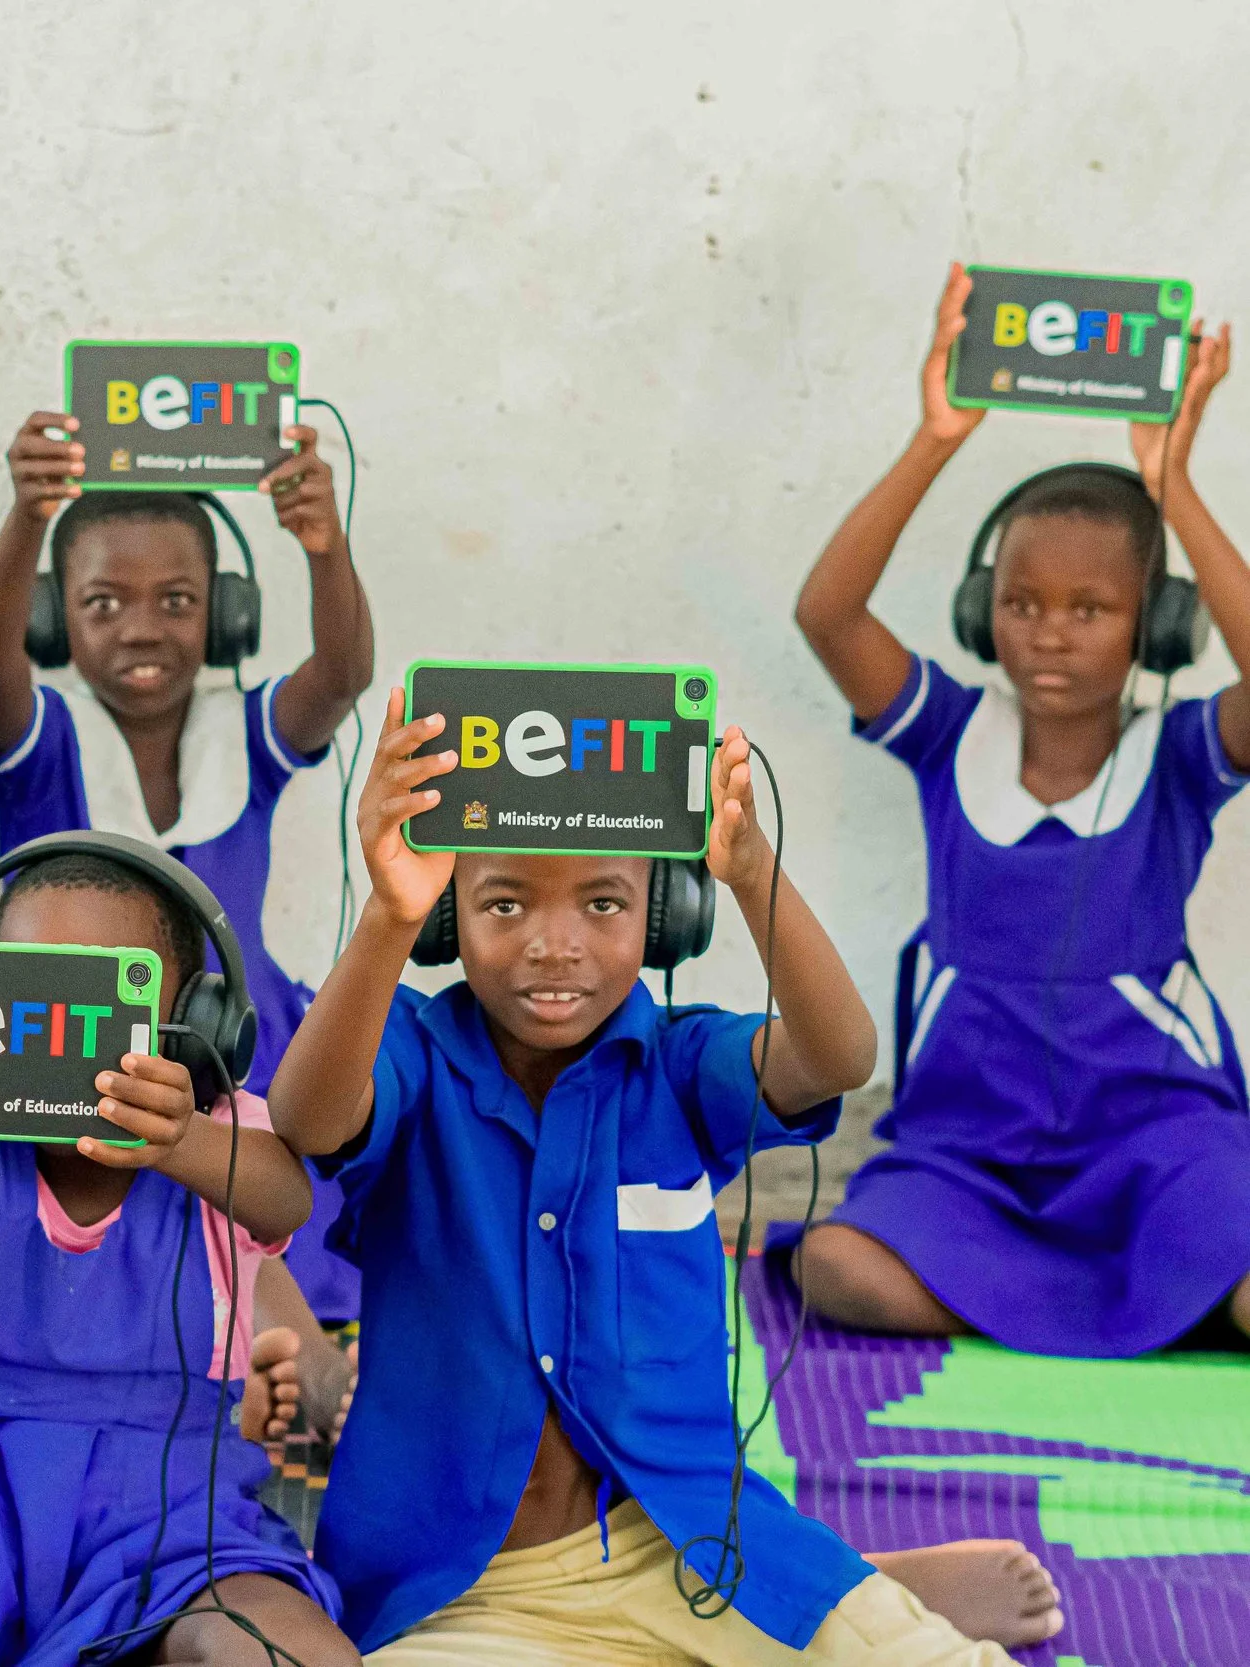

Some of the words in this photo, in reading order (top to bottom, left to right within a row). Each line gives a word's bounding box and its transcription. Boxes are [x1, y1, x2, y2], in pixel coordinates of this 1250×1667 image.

[993, 300, 1157, 357] BeFIT
[107, 376, 268, 430] BeFIT
[460, 711, 670, 777] BeFIT
[499, 811, 561, 830] Ministry
[566, 813, 583, 827] of
[587, 814, 663, 829] Education
[4, 1098, 21, 1112] of
